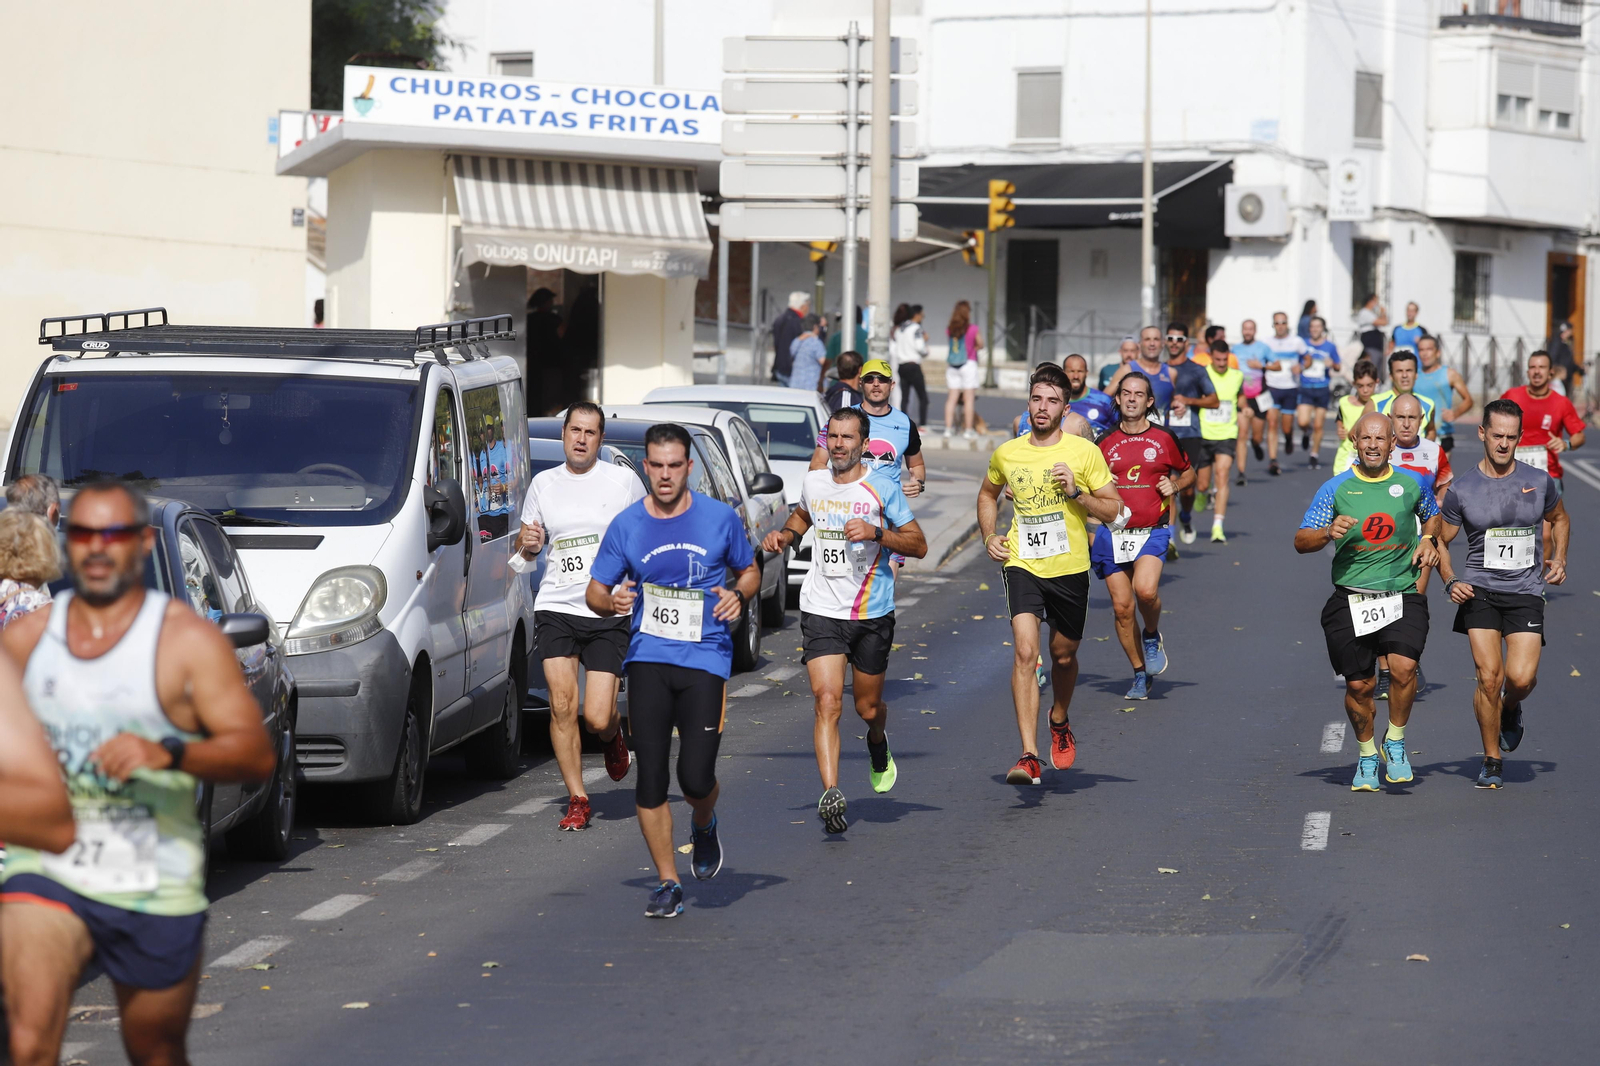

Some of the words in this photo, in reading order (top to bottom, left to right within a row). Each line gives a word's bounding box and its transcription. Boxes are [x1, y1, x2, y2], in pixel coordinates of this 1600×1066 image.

[390, 76, 540, 102] CHURROS
[571, 87, 720, 112] CHOCOLA
[433, 104, 578, 128] PATATAS
[589, 113, 699, 136] FRITAS
[475, 244, 528, 260] TOLDOS
[533, 243, 618, 268] ONUTAPI
[810, 499, 851, 514] HAPPY
[853, 502, 870, 514] GO
[1043, 514, 1060, 522] HUELVA
[578, 536, 596, 546] HUELVA
[1027, 532, 1048, 546] 547
[650, 543, 675, 556] VUELTA
[682, 543, 707, 556] HUELVA
[824, 548, 845, 564] 651
[1498, 545, 1513, 558] 71
[561, 555, 584, 573] 363
[654, 587, 672, 598] VUELTA
[678, 591, 700, 600] HUELVA
[652, 606, 679, 625] 463
[1362, 606, 1386, 624] 261
